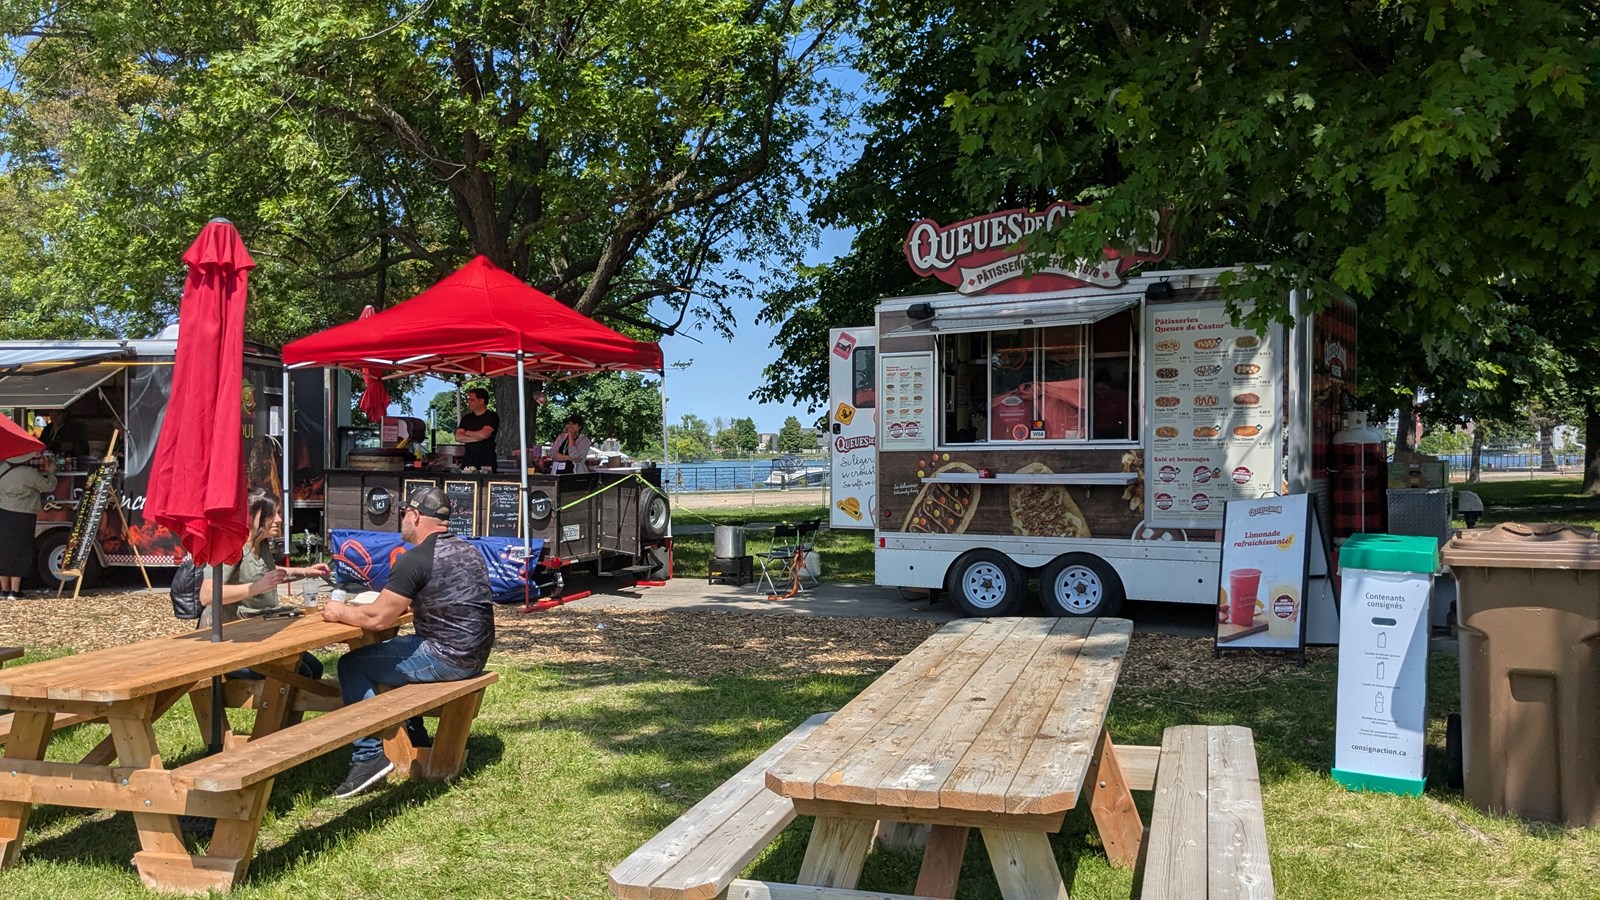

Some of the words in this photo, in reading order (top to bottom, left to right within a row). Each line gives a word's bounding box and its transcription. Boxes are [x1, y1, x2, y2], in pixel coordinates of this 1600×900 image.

[909, 213, 1023, 269] QUEUES
[1155, 325, 1184, 334] Queues
[1244, 530, 1281, 539] Limonade
[1365, 592, 1406, 602] Contenants
[1367, 600, 1403, 610] consignés
[1351, 744, 1407, 757] consignaction.ca
